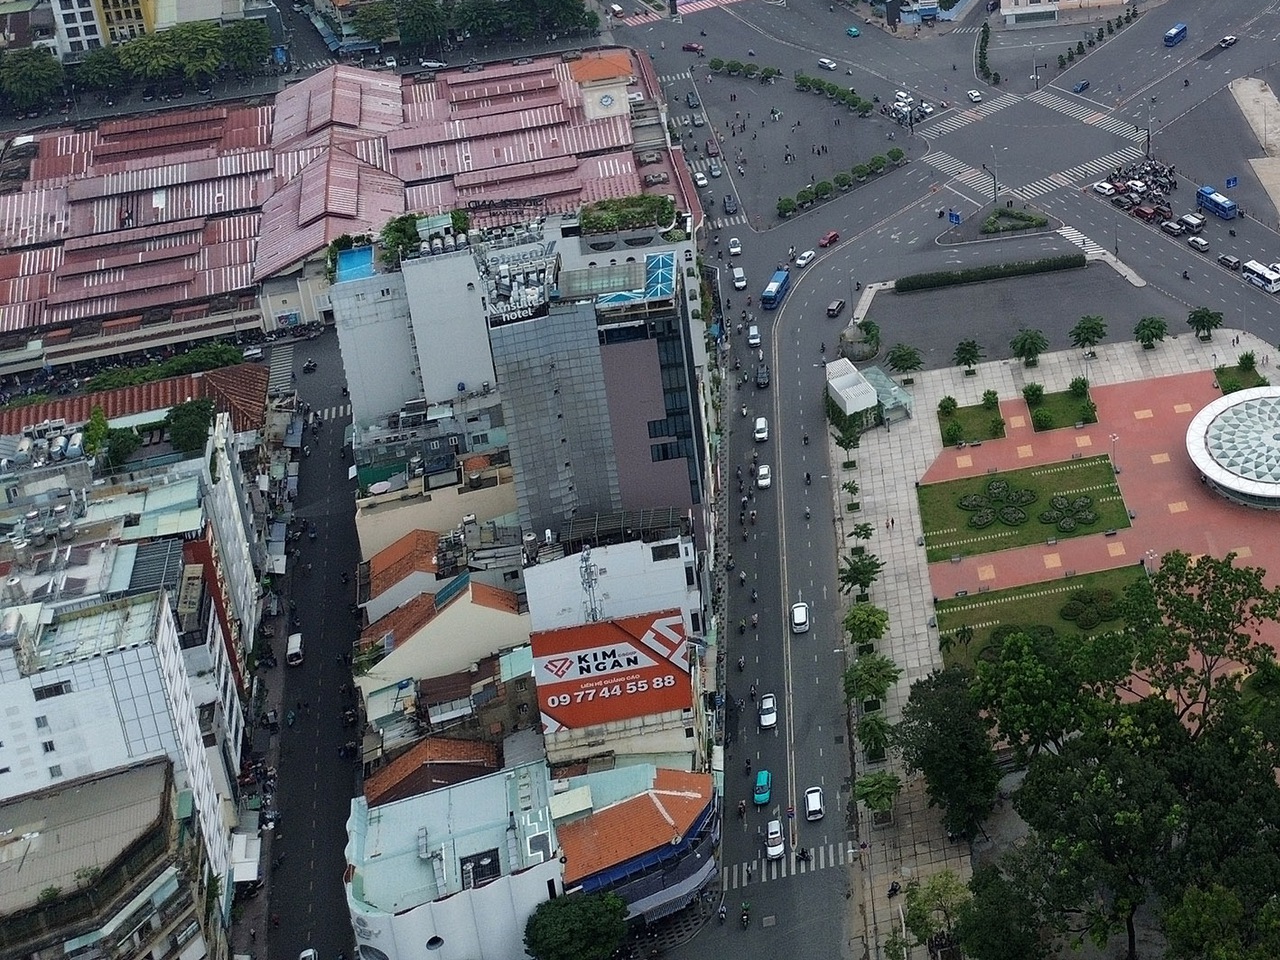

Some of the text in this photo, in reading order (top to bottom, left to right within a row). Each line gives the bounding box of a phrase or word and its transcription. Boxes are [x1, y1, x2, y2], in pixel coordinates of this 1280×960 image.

[502, 308, 534, 322] hotel
[577, 648, 617, 665] KIM
[579, 656, 639, 675] NGAN
[547, 675, 676, 708] 09 77 44 55 88
